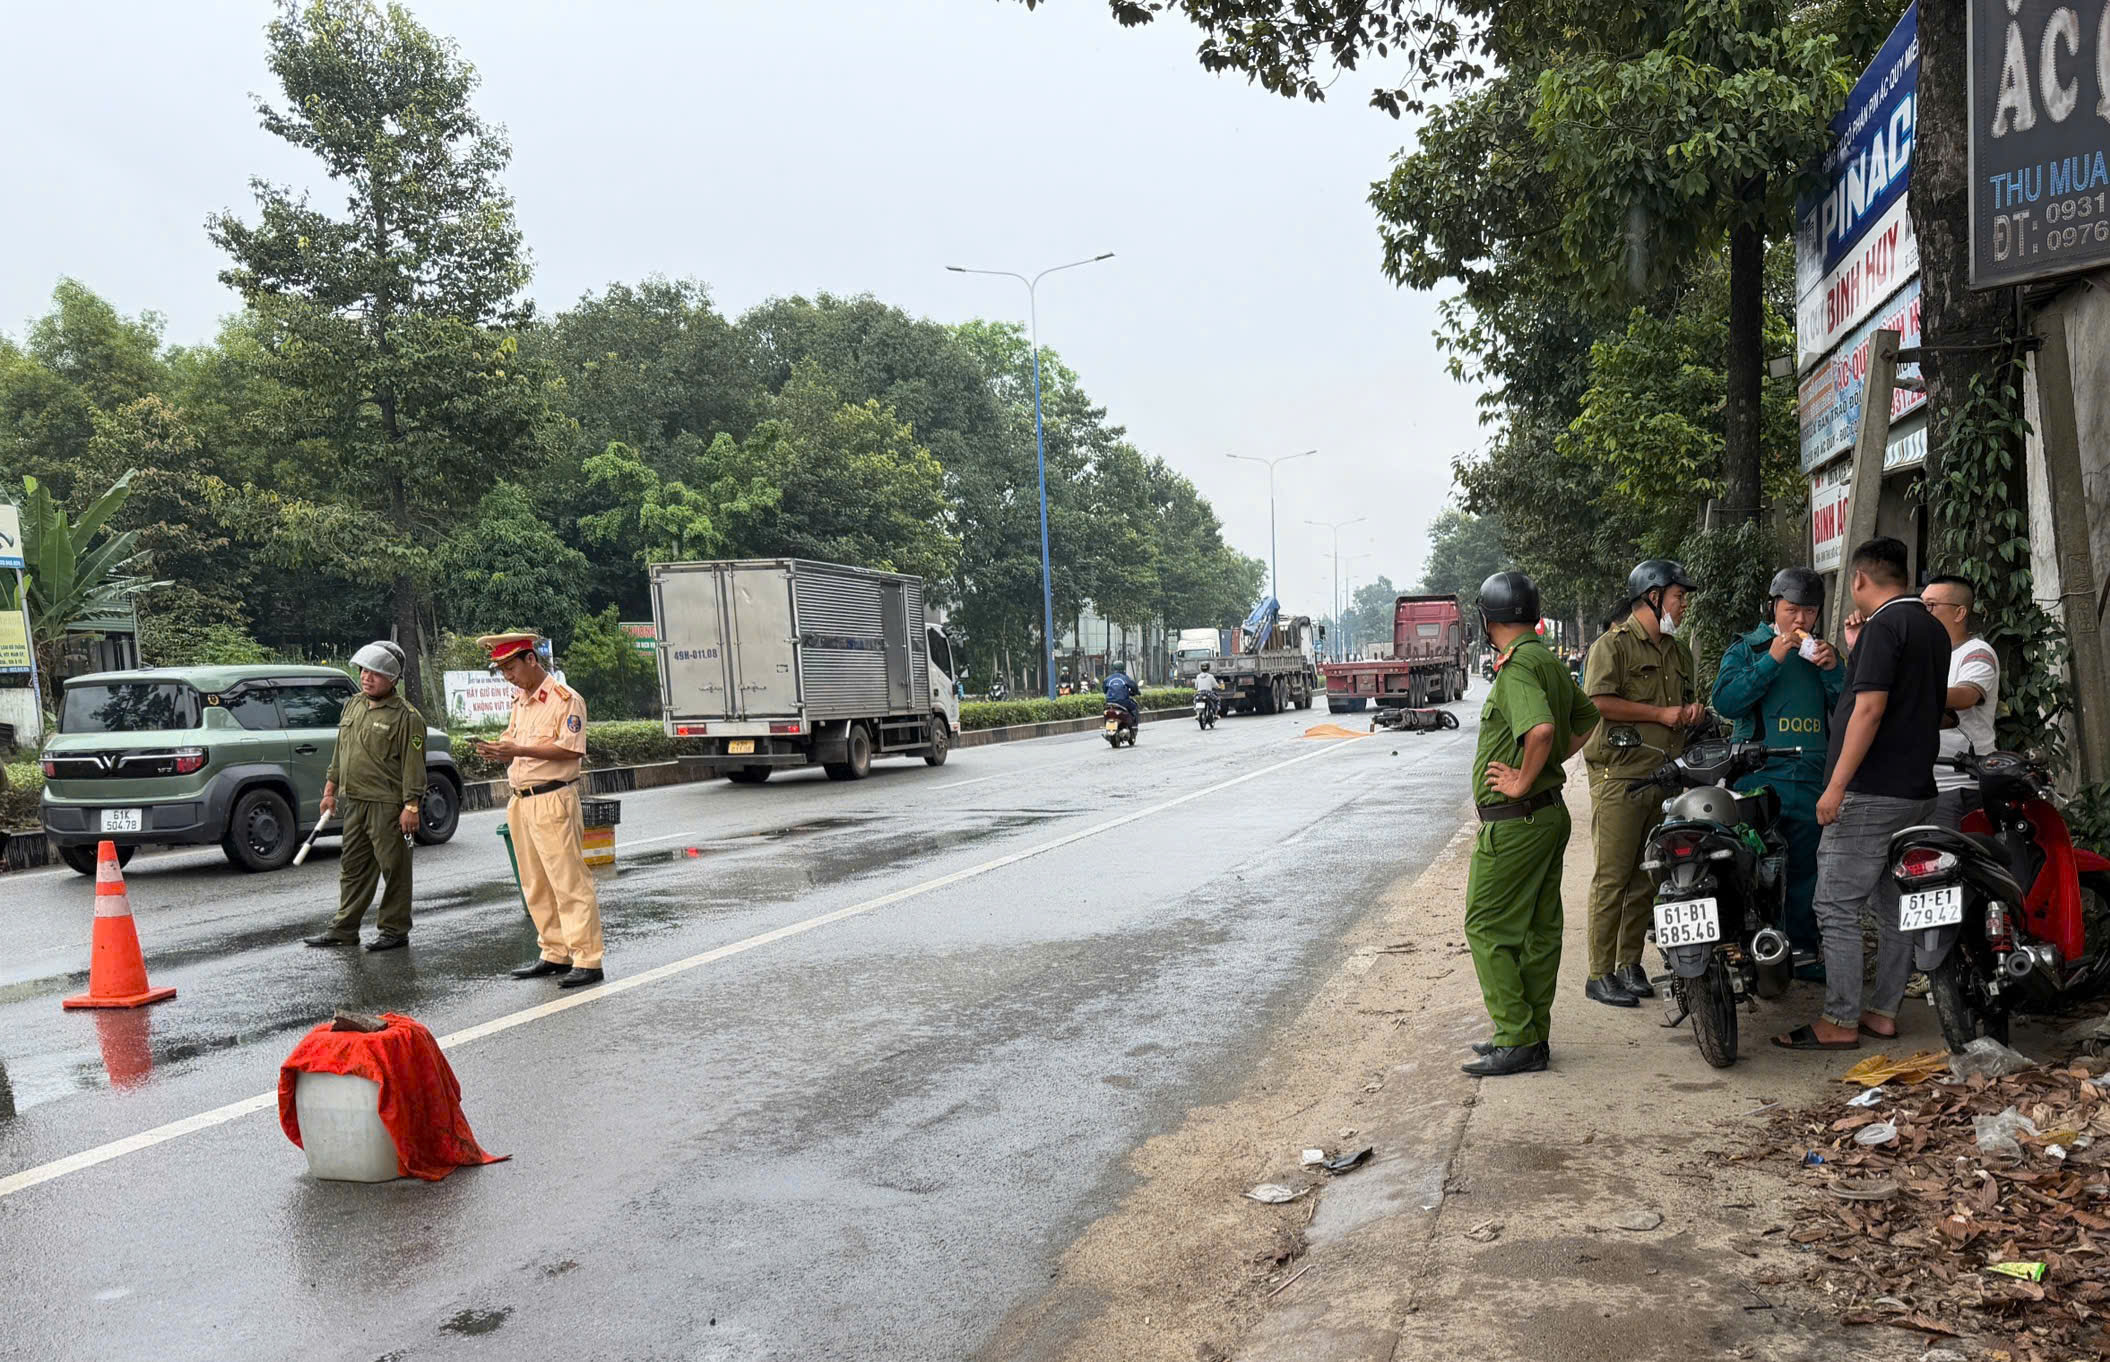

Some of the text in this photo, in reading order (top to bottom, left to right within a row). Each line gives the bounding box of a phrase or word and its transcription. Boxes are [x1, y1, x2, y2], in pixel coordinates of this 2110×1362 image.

[1868, 89, 1879, 120] PIN
[1822, 90, 1917, 260] PINAC
[1989, 150, 2110, 209] THU MUA
[2046, 192, 2105, 224] 0931
[2046, 219, 2110, 251] 0976
[1827, 271, 1860, 335] BÌNH
[1866, 220, 1899, 305] HUY
[1814, 502, 1835, 545] BÌNH
[113, 810, 130, 820] 61K
[1664, 903, 1706, 925] 61-B1
[1909, 889, 1952, 910] 61-E1
[1660, 921, 1715, 945] 585.46
